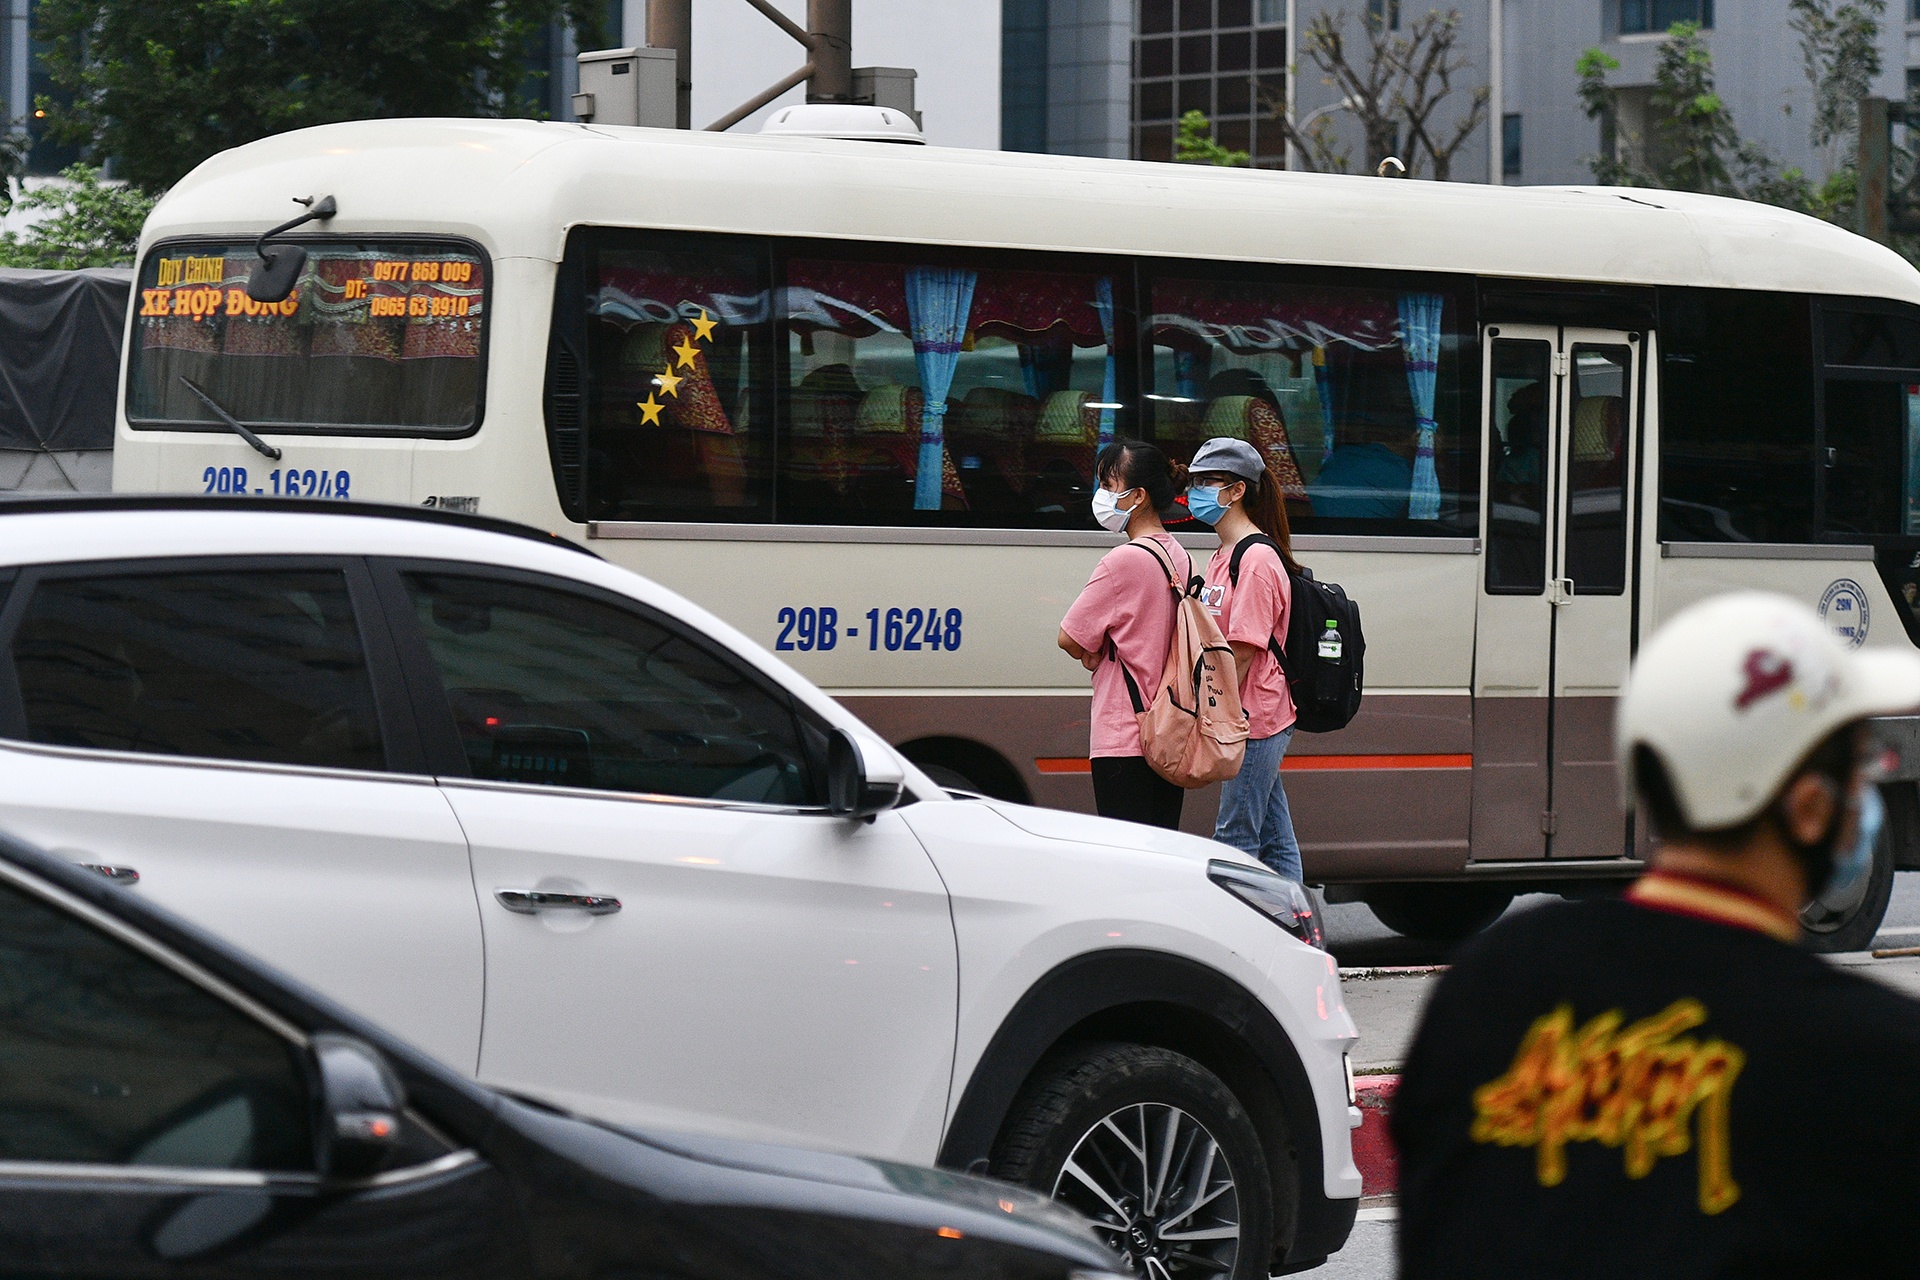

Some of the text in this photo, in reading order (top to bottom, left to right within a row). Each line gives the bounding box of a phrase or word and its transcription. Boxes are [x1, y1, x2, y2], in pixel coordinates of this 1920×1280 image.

[158, 258, 183, 286] DUY
[373, 262, 472, 282] 0977 868 009
[140, 289, 171, 316] XE
[173, 285, 223, 322] HỢP
[370, 297, 469, 316] 0965 63 8910
[866, 607, 962, 651] 16248
